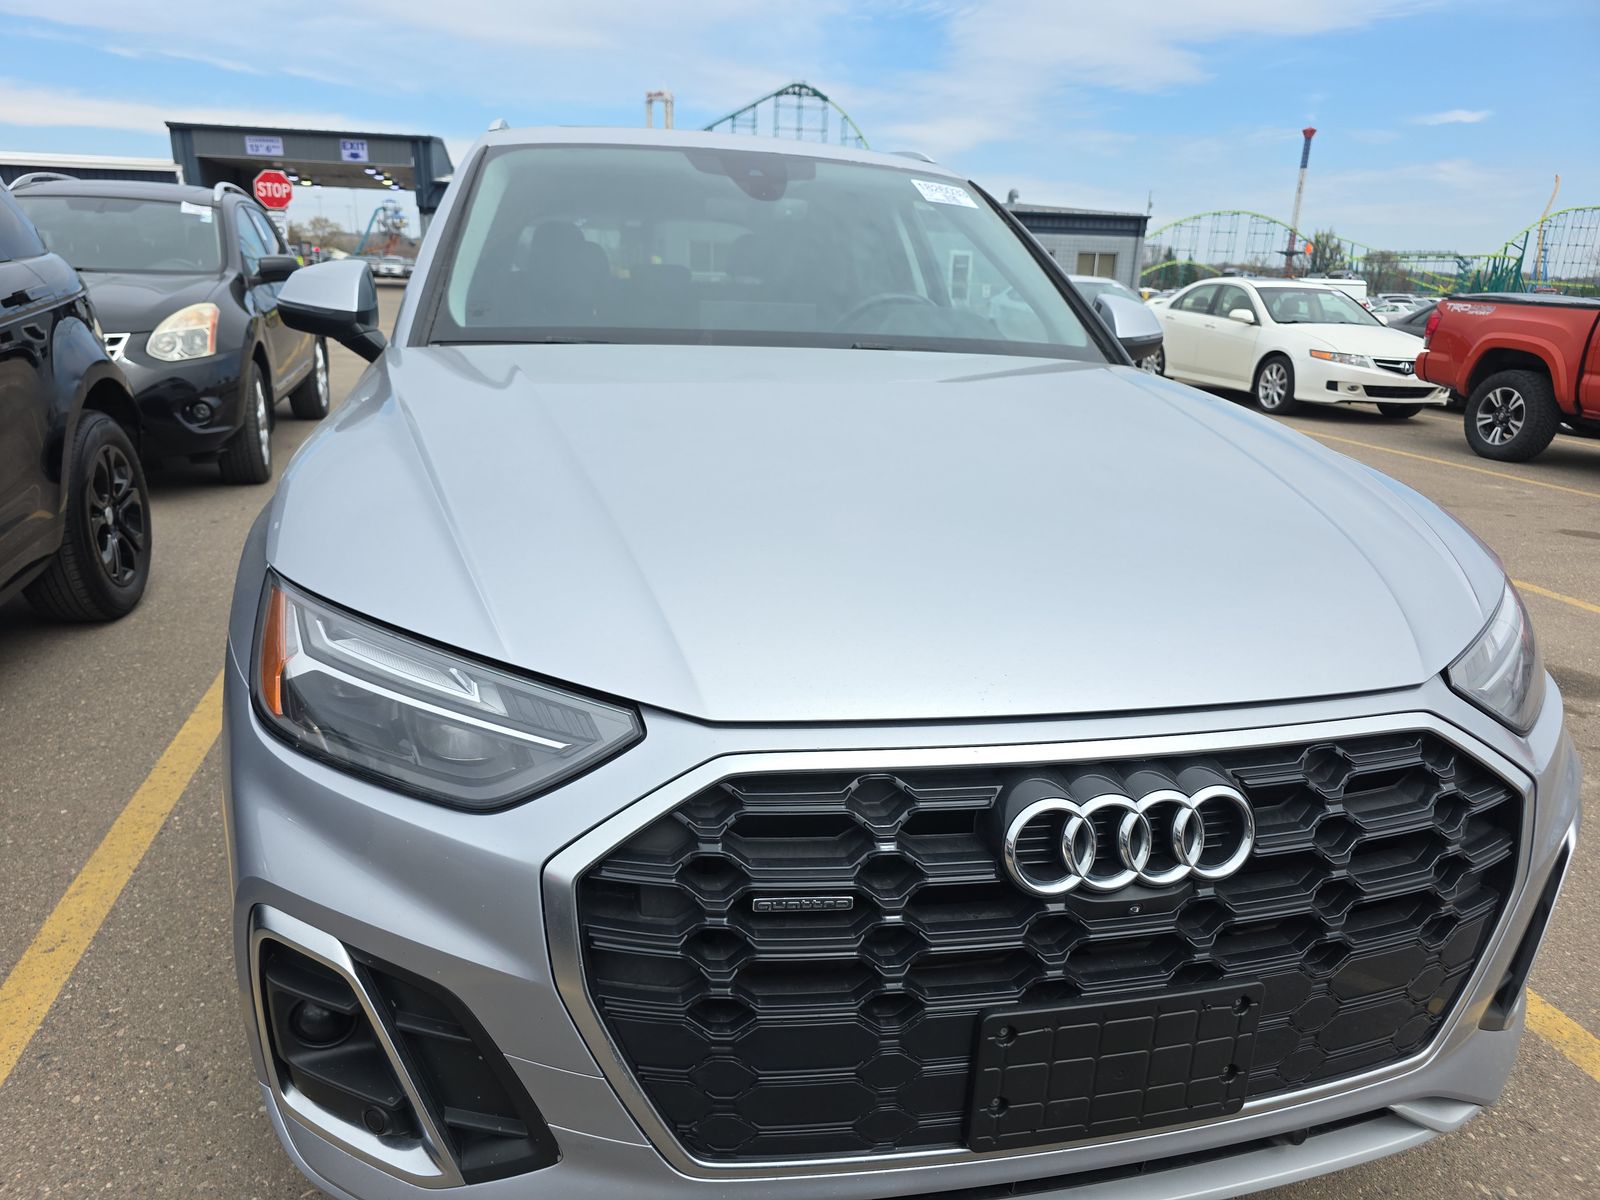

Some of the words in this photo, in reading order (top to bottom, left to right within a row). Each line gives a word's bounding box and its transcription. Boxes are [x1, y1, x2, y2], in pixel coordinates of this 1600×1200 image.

[342, 141, 365, 151] EXIT
[257, 182, 291, 198] STOP
[1446, 302, 1472, 312] TRD
[757, 899, 850, 911] quattro
